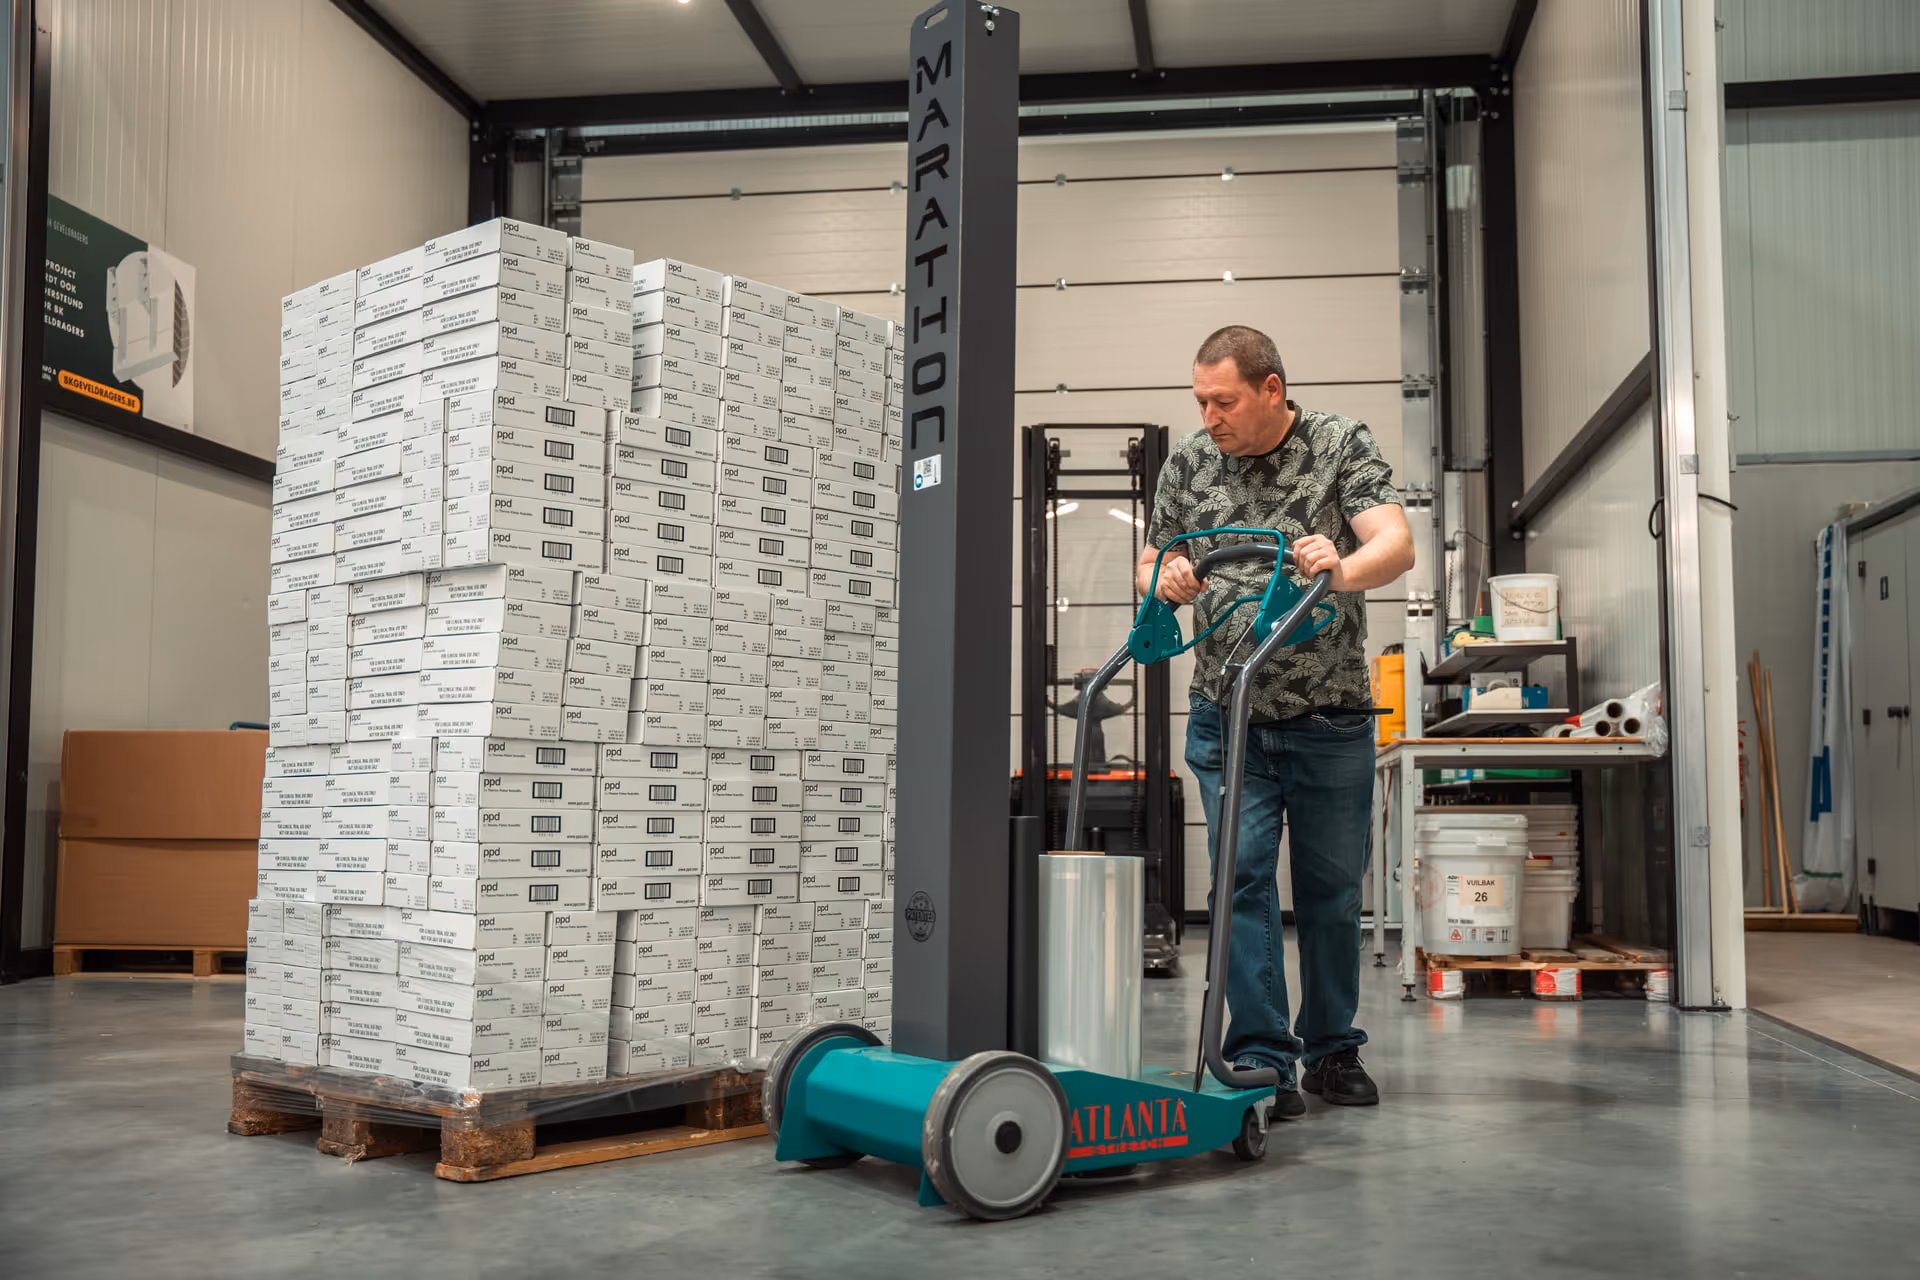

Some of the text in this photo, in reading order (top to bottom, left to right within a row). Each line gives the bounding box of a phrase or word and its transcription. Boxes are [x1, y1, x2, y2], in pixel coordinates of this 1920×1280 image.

[503, 222, 519, 232] ppd
[53, 220, 89, 245] GEVELDRAGERS
[425, 242, 436, 253] ppd
[575, 242, 590, 251] ppd
[911, 40, 952, 450] MARATHON
[502, 257, 519, 267] ppd
[45, 258, 77, 280] PROJECT
[668, 263, 682, 273] ppd
[574, 275, 590, 284] ppd
[734, 280, 748, 289] ppd
[59, 279, 77, 294] OOK
[500, 291, 516, 301] ppd
[666, 295, 680, 305] ppd
[787, 295, 800, 304] ppd
[54, 304, 64, 316] BK
[422, 308, 433, 318] ppd
[572, 307, 588, 316] ppd
[732, 311, 746, 320] ppd
[44, 314, 85, 339] ELDRAGERS
[501, 326, 518, 335] ppd
[666, 328, 681, 337] ppd
[573, 341, 589, 350] ppd
[730, 342, 744, 351] ppd
[501, 360, 517, 370] ppd
[664, 359, 678, 368] ppd
[422, 372, 434, 383] ppd
[572, 374, 587, 383] ppd
[726, 372, 740, 381] ppd
[63, 375, 137, 409] BKGEVELDRAGERS.BE
[664, 392, 678, 401] ppd
[450, 399, 461, 409] ppd
[497, 395, 515, 406] ppd
[727, 404, 740, 413] ppd
[624, 416, 640, 426] ppd
[496, 430, 514, 440] ppd
[726, 436, 741, 446] ppd
[618, 449, 635, 459] ppd
[819, 453, 832, 462] ppd
[496, 465, 514, 475] ppd
[724, 468, 739, 477] ppd
[615, 482, 631, 492] ppd
[817, 483, 831, 491] ppd
[494, 499, 513, 509] ppd
[721, 499, 737, 508] ppd
[614, 515, 630, 524] ppd
[815, 513, 829, 521] ppd
[493, 533, 511, 543] ppd
[719, 530, 734, 539] ppd
[814, 542, 828, 551] ppd
[614, 547, 630, 557] ppd
[719, 561, 733, 571] ppd
[508, 568, 525, 578] ppd
[813, 572, 826, 581] ppd
[584, 576, 600, 585] ppd
[654, 584, 669, 593] ppd
[716, 591, 731, 600] ppd
[427, 607, 439, 616] ppd
[507, 603, 523, 612] ppd
[583, 609, 599, 618] ppd
[653, 617, 668, 626] ppd
[715, 623, 729, 633] ppd
[502, 637, 518, 646] ppd
[575, 642, 591, 651] ppd
[650, 650, 665, 659] ppd
[712, 655, 727, 663] ppd
[772, 660, 784, 668] ppd
[498, 671, 514, 681] ppd
[569, 676, 585, 685] ppd
[650, 683, 664, 692] ppd
[712, 687, 726, 696] ppd
[495, 706, 512, 715] ppd
[566, 711, 582, 720] ppd
[647, 715, 661, 725] ppd
[709, 719, 723, 728] ppd
[488, 741, 506, 753] ppd
[606, 747, 622, 758] ppd
[711, 751, 726, 761] ppd
[807, 753, 821, 763] ppd
[483, 777, 501, 788] ppd
[604, 780, 621, 792] ppd
[712, 782, 727, 793] ppd
[805, 783, 818, 793] ppd
[482, 812, 500, 823] ppd
[602, 814, 619, 825] ppd
[710, 815, 725, 825] ppd
[803, 814, 816, 824] ppd
[483, 847, 501, 859] ppd
[601, 847, 617, 859] ppd
[709, 846, 725, 856] ppd
[708, 876, 723, 888] ppd
[802, 875, 816, 885] ppd
[480, 882, 498, 893] ppd
[601, 881, 617, 892] ppd
[1474, 892, 1488, 902] 26
[401, 911, 413, 921] ppd
[639, 911, 654, 922] ppd
[700, 907, 714, 918] ppd
[478, 917, 495, 928] ppd
[555, 915, 571, 925] ppd
[699, 940, 713, 951] ppd
[761, 937, 775, 947] ppd
[552, 949, 568, 960] ppd
[638, 944, 653, 955] ppd
[478, 952, 495, 963] ppd
[699, 971, 714, 982] ppd
[638, 977, 652, 988] ppd
[476, 987, 493, 999] ppd
[549, 983, 565, 994] ppd
[697, 1004, 711, 1015] ppd
[635, 1010, 649, 1021] ppd
[475, 1022, 492, 1034] ppd
[546, 1018, 562, 1029] ppd
[696, 1036, 710, 1047] ppd
[396, 1048, 406, 1056] ppd
[631, 1043, 646, 1055] ppd
[544, 1052, 560, 1064] ppd
[473, 1058, 490, 1070] ppd
[1072, 1097, 1187, 1144] ATLANTA
